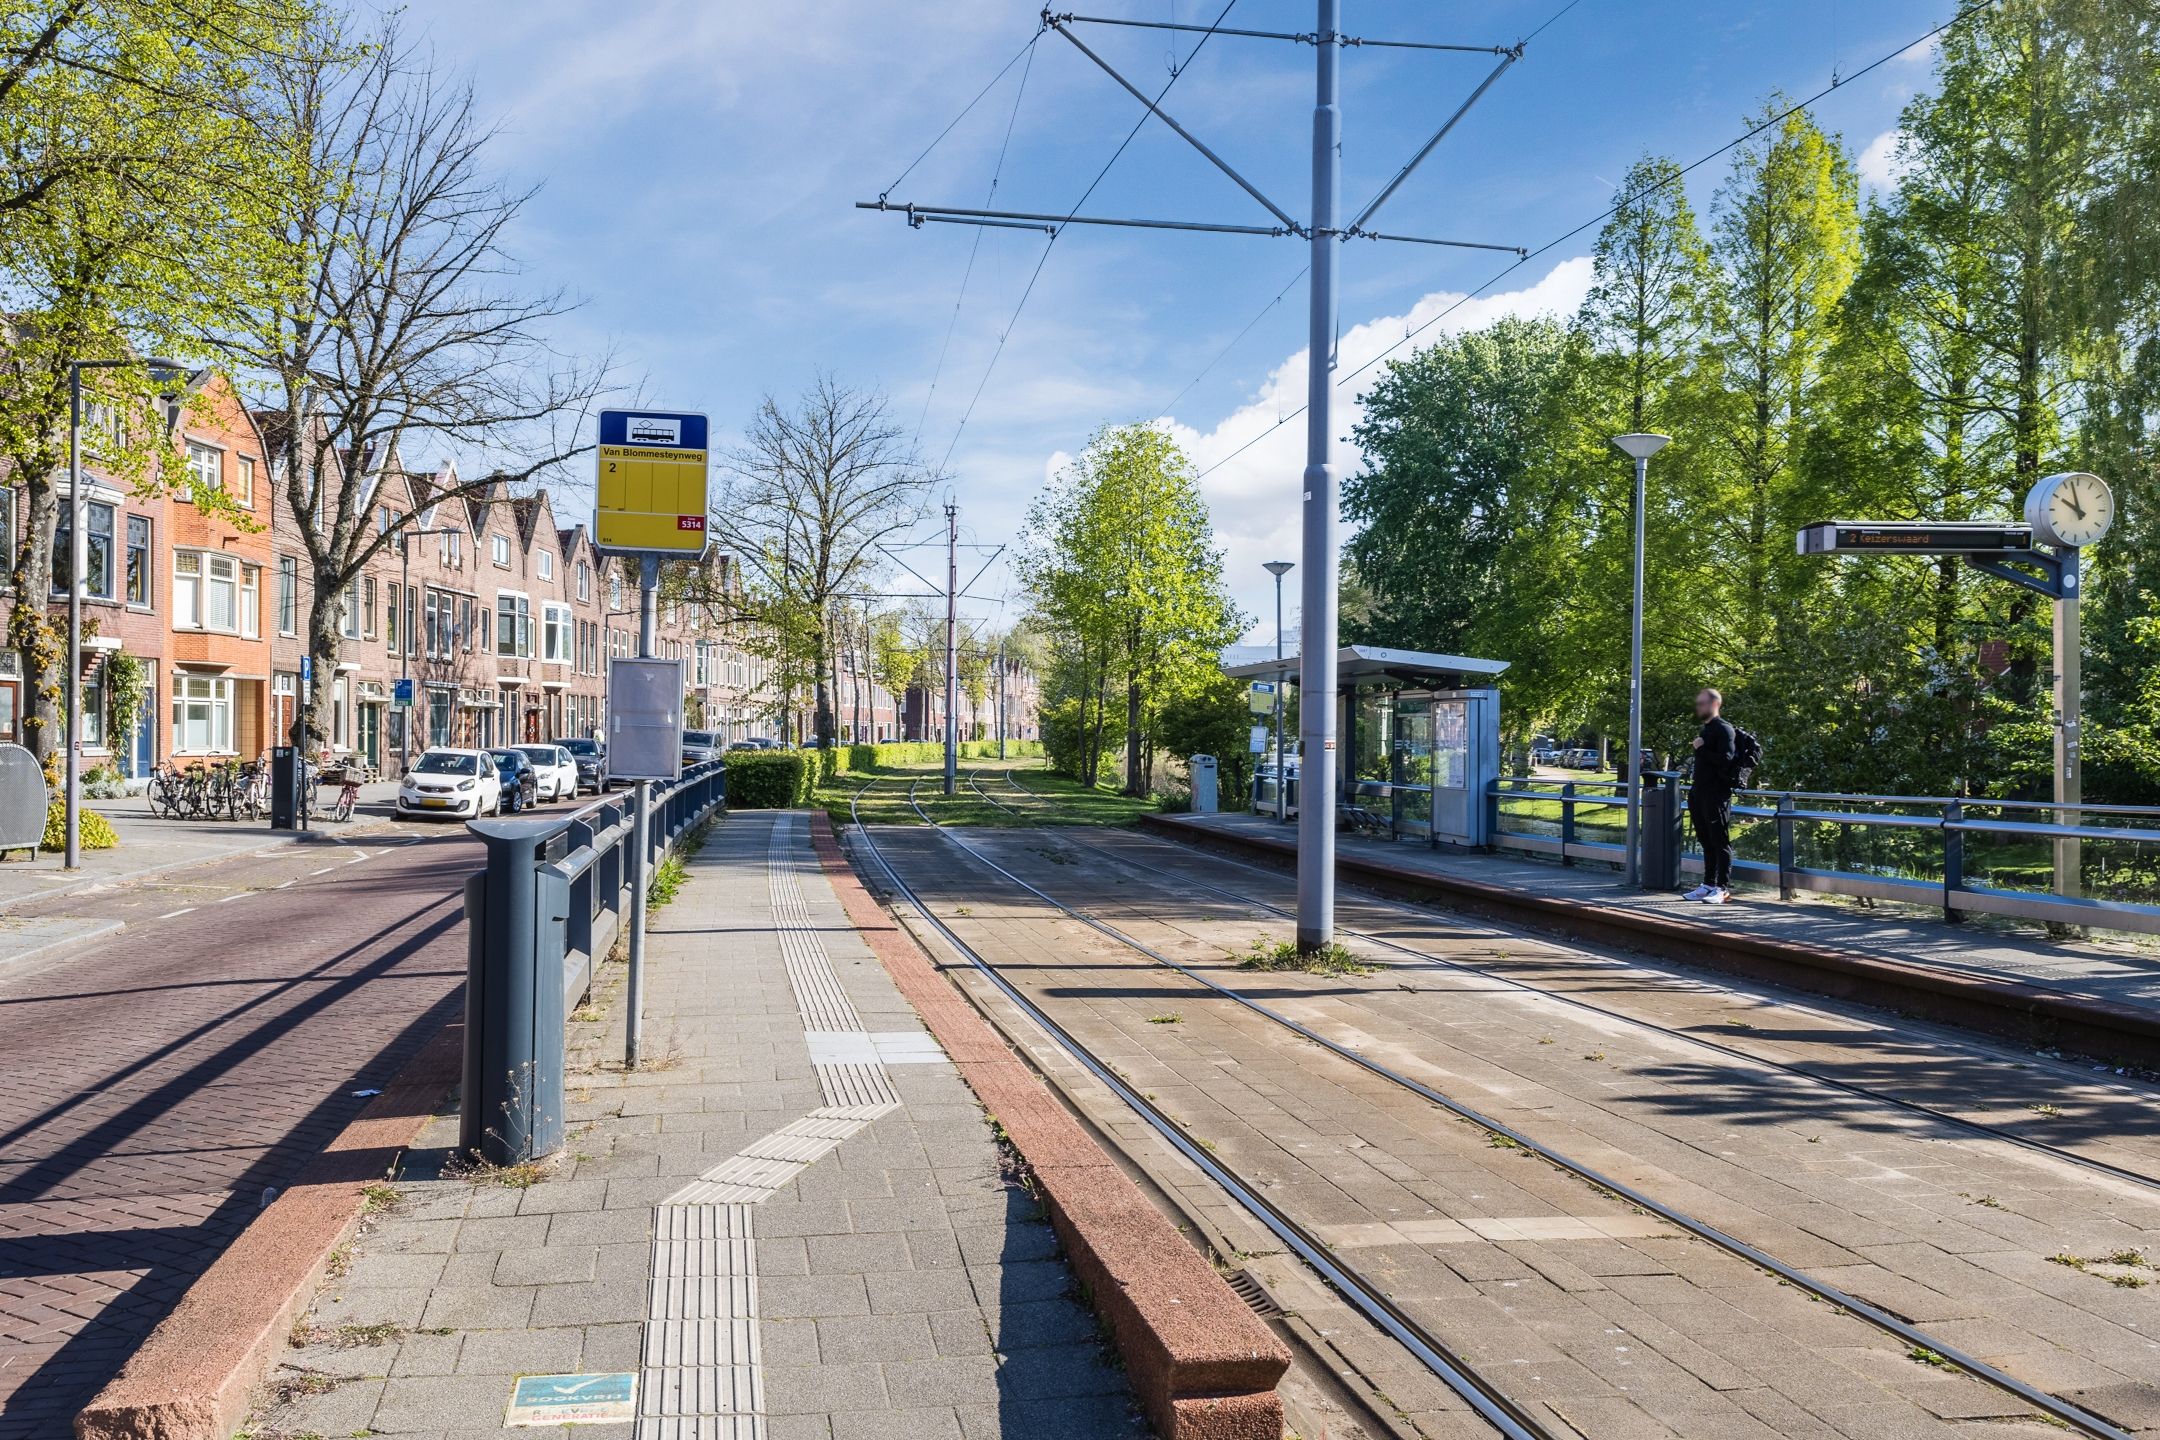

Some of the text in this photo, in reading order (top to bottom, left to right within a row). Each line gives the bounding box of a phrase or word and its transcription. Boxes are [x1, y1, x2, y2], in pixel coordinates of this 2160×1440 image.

[603, 447, 703, 461] Van Blommesteynweg
[608, 462, 617, 473] 2
[1849, 533, 1929, 544] 2 Keizerswaard
[304, 659, 309, 677] P
[395, 680, 403, 689] P
[525, 1394, 622, 1403] ROOKVRIJ
[531, 1412, 609, 1421] GENERATIE
